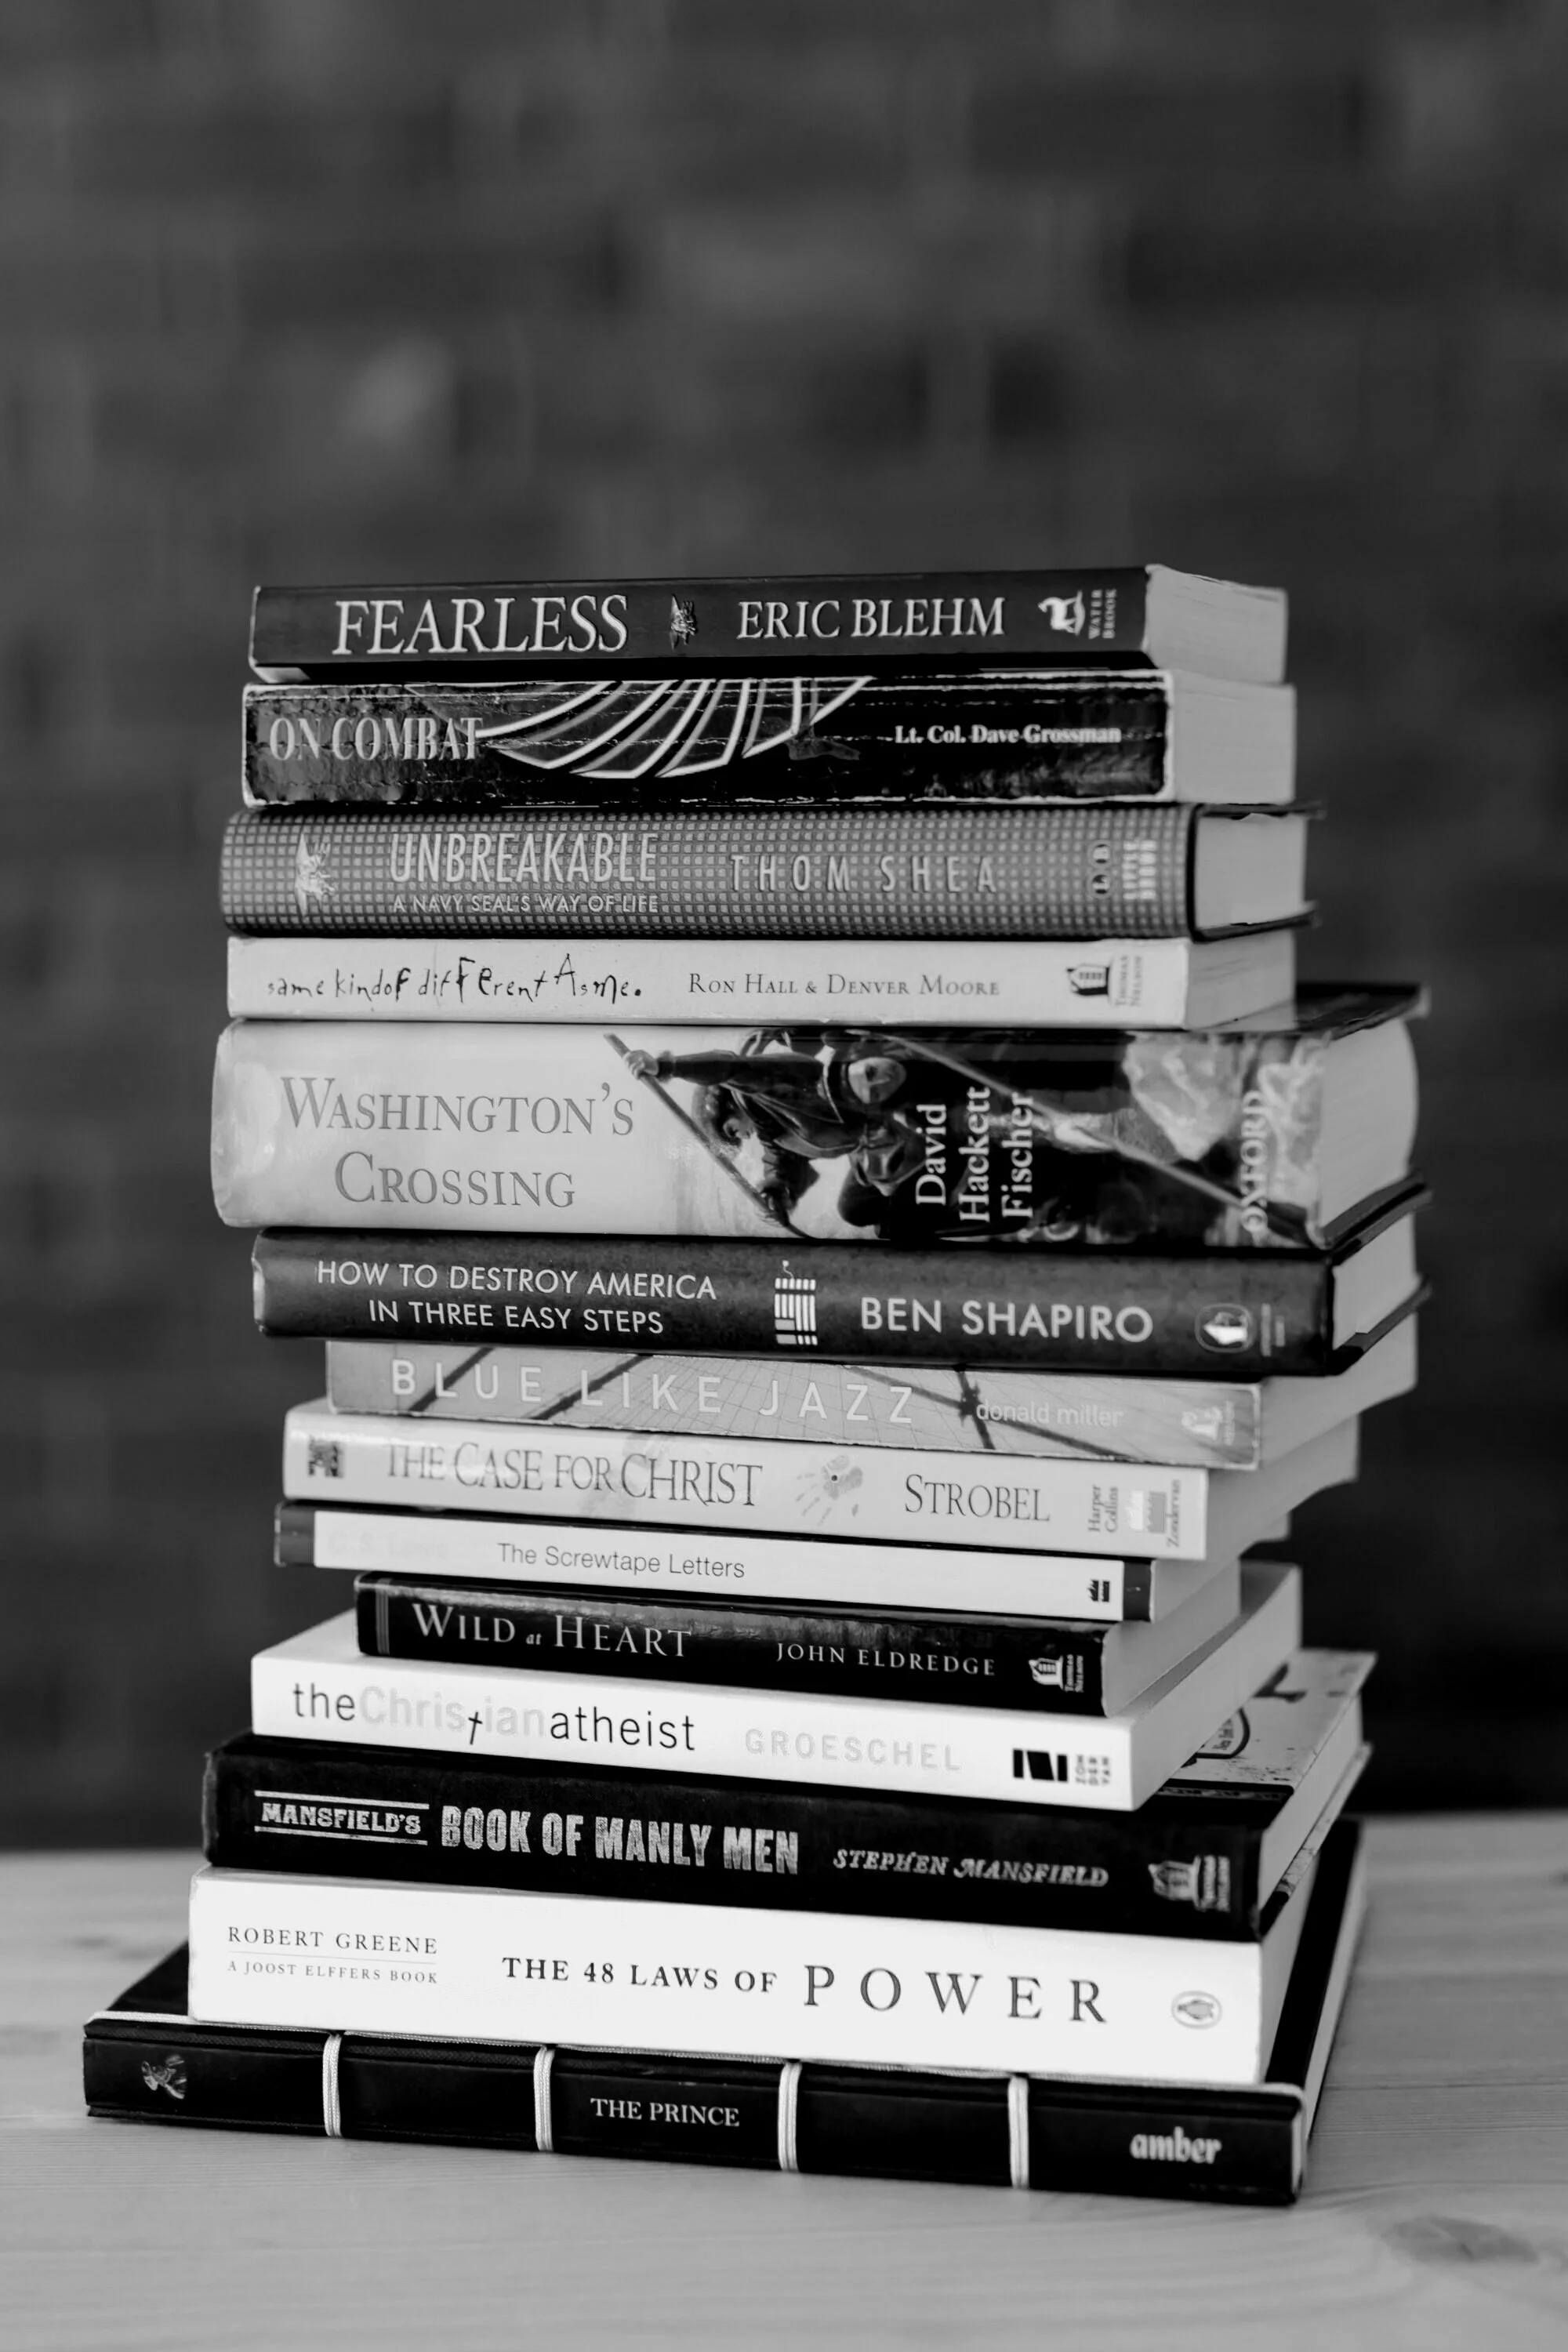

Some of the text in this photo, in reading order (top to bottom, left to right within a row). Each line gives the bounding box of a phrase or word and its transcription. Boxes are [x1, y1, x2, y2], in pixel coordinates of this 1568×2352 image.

[333, 594, 627, 655] FEARLESS
[738, 597, 1005, 639] ERIC BLEHM
[1088, 590, 1102, 639] WATER
[1102, 589, 1116, 639] BROOK
[270, 717, 484, 760] ON COMBAT
[895, 725, 1122, 744] Lt. Col. Dave Grossman
[390, 832, 659, 884] UNBREAKABLE
[730, 855, 997, 893] THOM SHEA
[393, 895, 659, 913] A NAVY SEAL'S WAY OF LIFE
[688, 973, 1000, 997] RON HALL & DENVER MOORE
[281, 1076, 634, 1136] WASHINGTON'S
[915, 1103, 947, 1206] David
[959, 1086, 990, 1223] Hackett
[1002, 1094, 1034, 1218] Fischer
[335, 1151, 575, 1208] CROSSING
[317, 1260, 717, 1301] HOW TO DESTROY AMERICA
[368, 1299, 664, 1334] IN THREE EASY STEPS
[863, 1296, 1153, 1342] BEN SHAPIRO
[392, 1359, 913, 1424] BLUE LIKE JAZZ
[976, 1399, 1124, 1428] donald miller
[385, 1441, 1051, 1522] THE CASE FOR CHRIST STROBEL
[1087, 1484, 1105, 1533] Harper
[498, 1542, 746, 1579] The Screwtape Letters
[412, 1602, 692, 1657] WILD at HEART
[776, 1642, 996, 1676] JOHN ELDREDGE
[745, 1727, 962, 1772] GROESCHEL
[261, 1802, 799, 1875] MANSFIELD'S BOOK OF MANLY MEN
[833, 1848, 1109, 1888] STEPHEN MANSFIELD
[227, 1926, 438, 1955] ROBERT GREENE
[227, 1961, 438, 1984] A JOOST ELFFERS BOOK
[502, 1957, 1108, 2024] THE 48 LAWS OF POWER
[590, 2097, 741, 2128] THE PRINCE
[1130, 2125, 1222, 2165] amber
